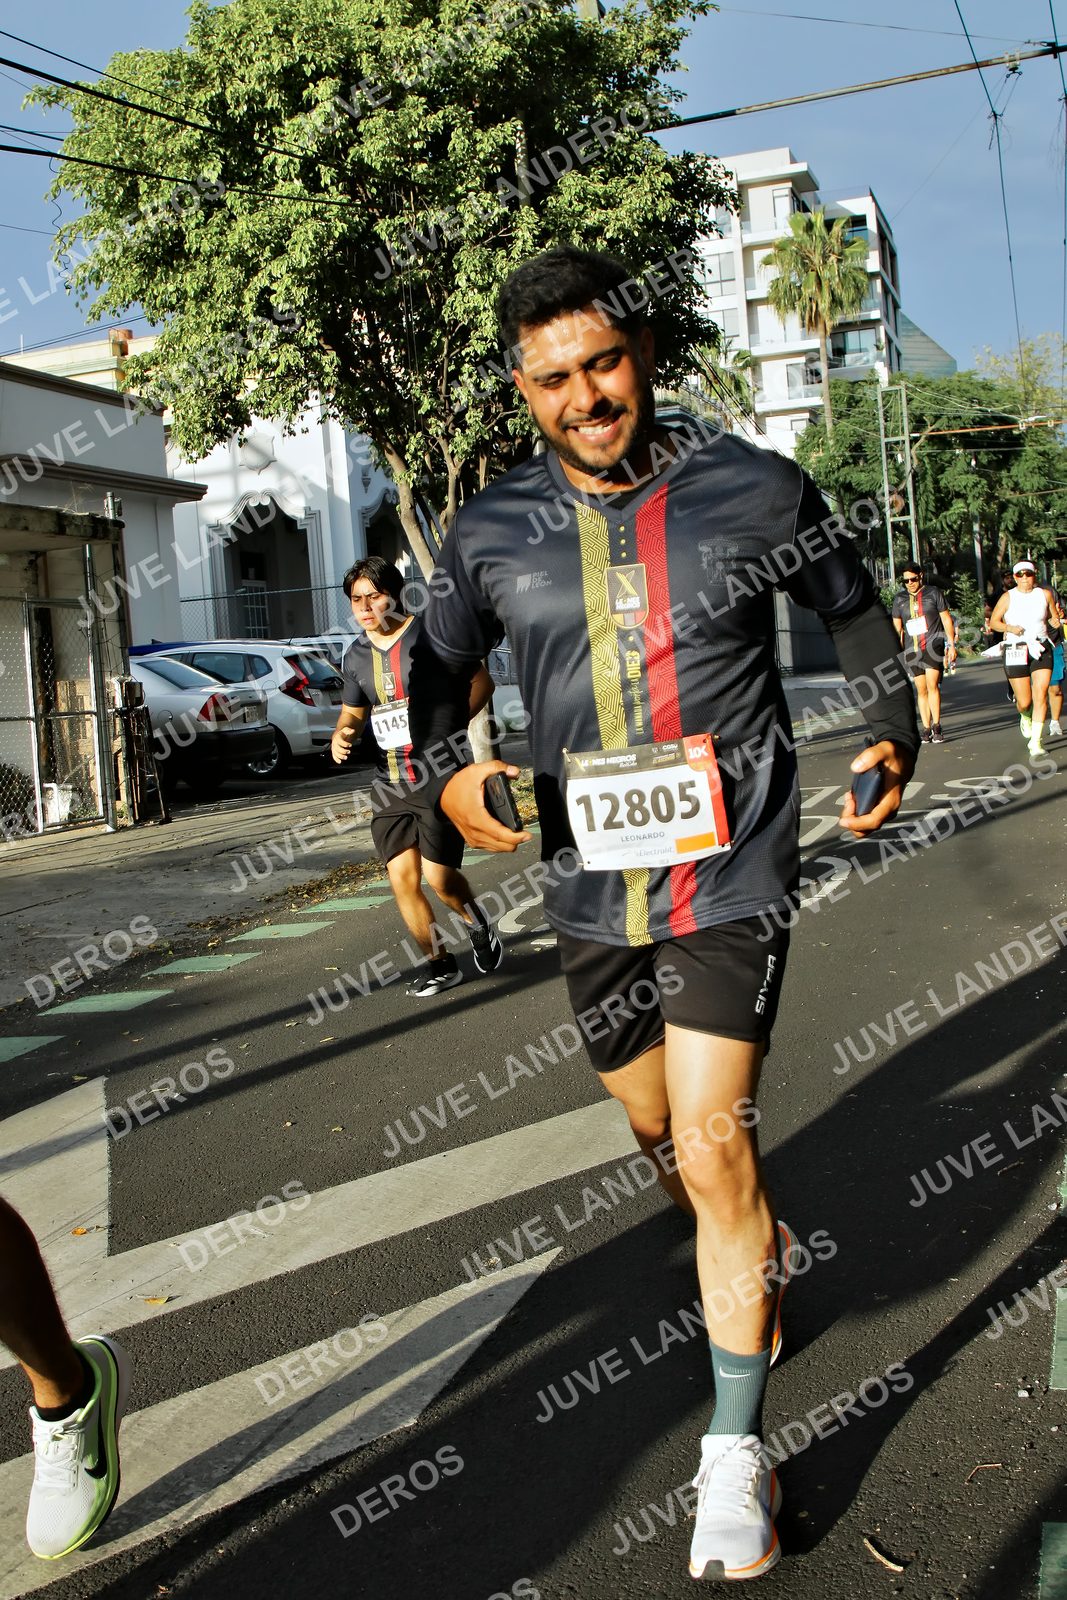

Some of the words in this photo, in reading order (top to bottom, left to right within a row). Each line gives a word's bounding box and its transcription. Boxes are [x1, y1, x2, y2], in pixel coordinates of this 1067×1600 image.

[375, 713, 409, 735] 1145
[687, 745, 709, 760] 10K
[575, 780, 701, 832] 12805
[620, 831, 666, 843] LEONARDO
